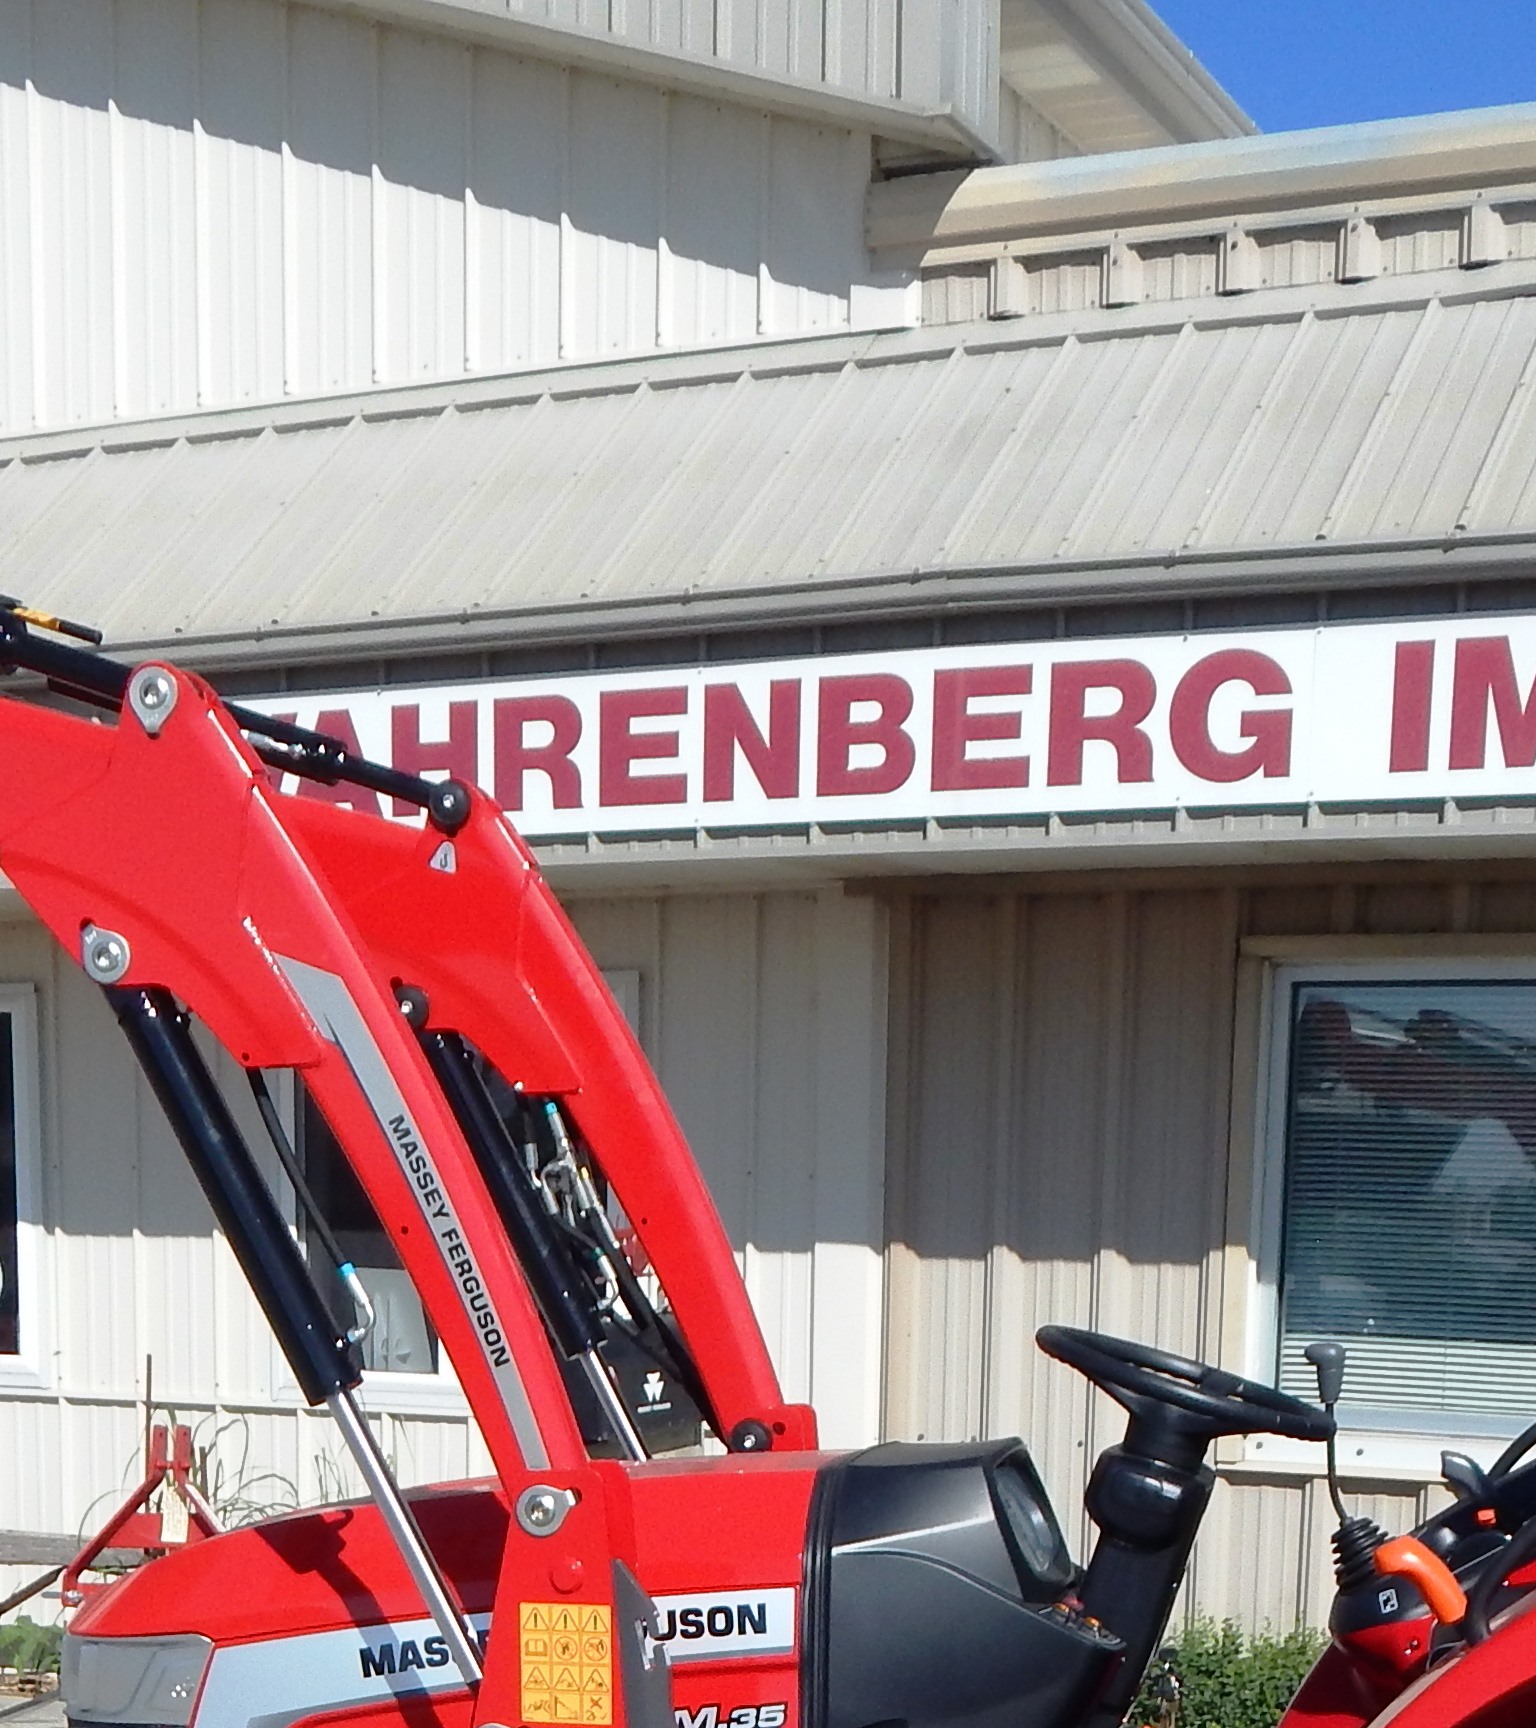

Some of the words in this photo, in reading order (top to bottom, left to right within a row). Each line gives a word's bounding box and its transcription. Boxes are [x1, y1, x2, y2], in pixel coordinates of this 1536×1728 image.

[264, 646, 1293, 819] AHRENBERG
[388, 1114, 450, 1219] MASSEY
[441, 1227, 510, 1368] FERGUSON
